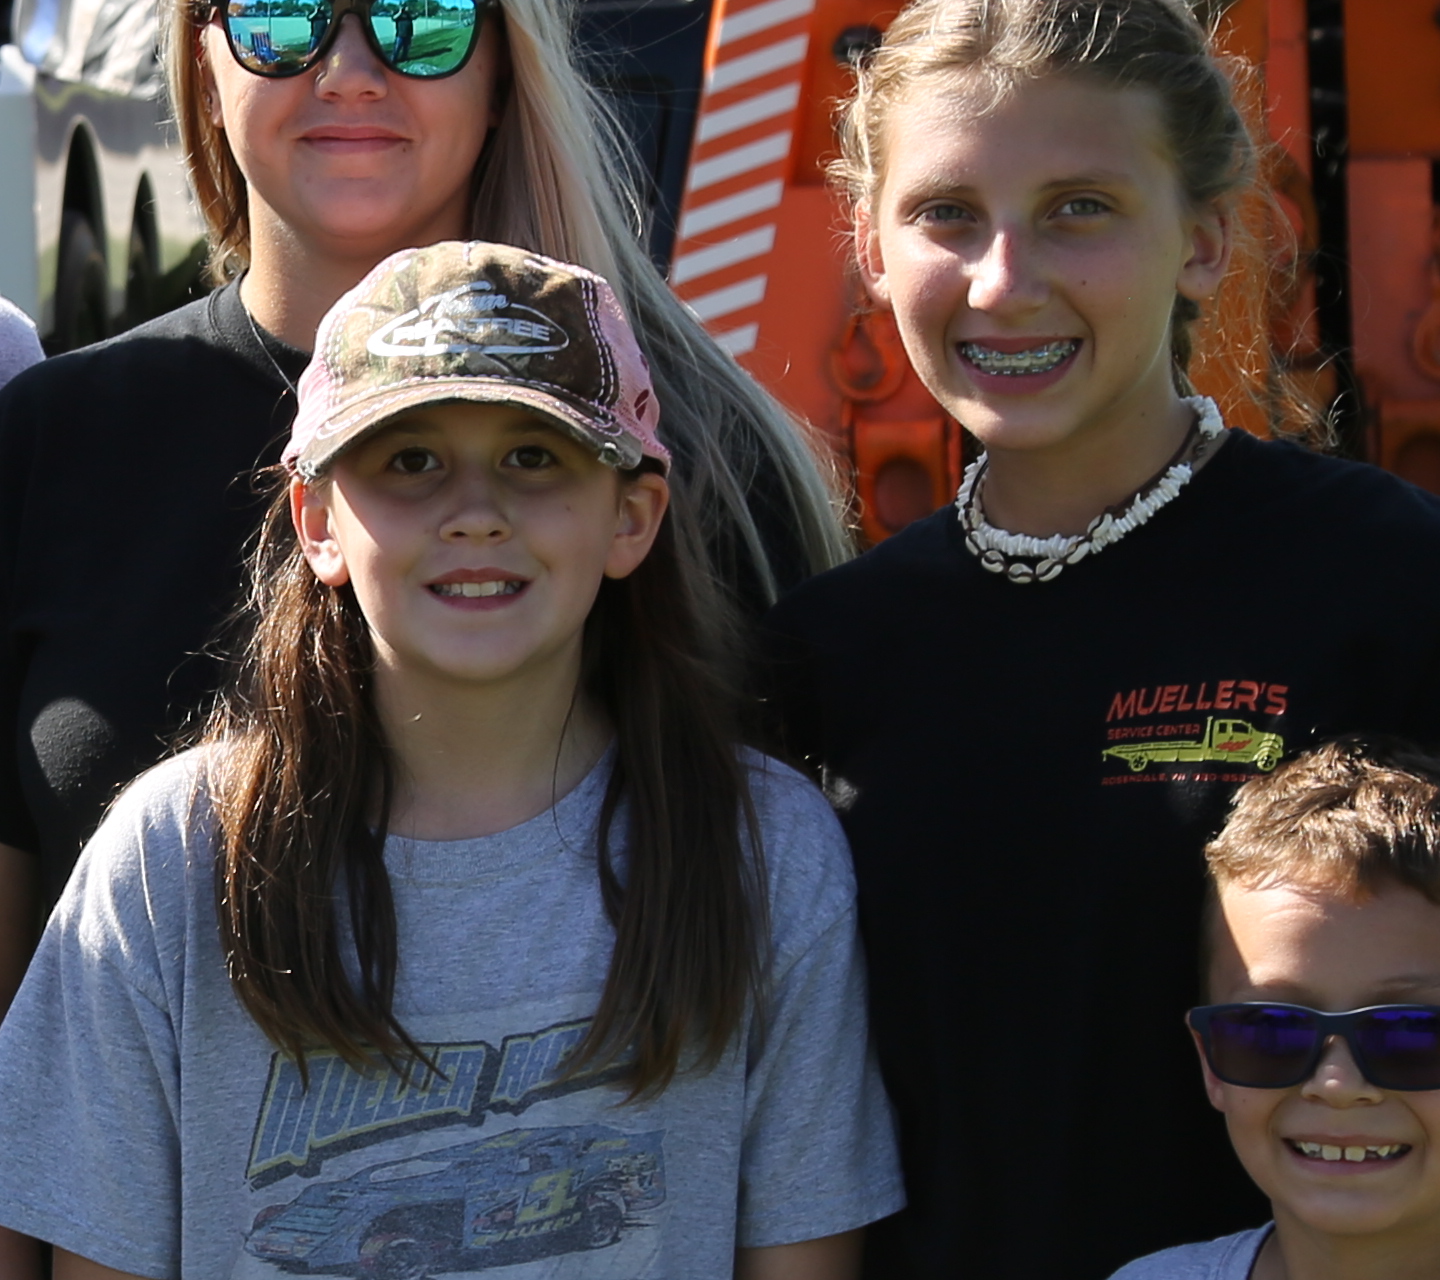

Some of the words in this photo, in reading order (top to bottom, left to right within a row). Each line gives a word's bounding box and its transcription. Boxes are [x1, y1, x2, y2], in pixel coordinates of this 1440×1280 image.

[1105, 680, 1289, 723] MUELLER'S
[1107, 726, 1154, 740] SERVICE
[1156, 724, 1201, 737] CENTER
